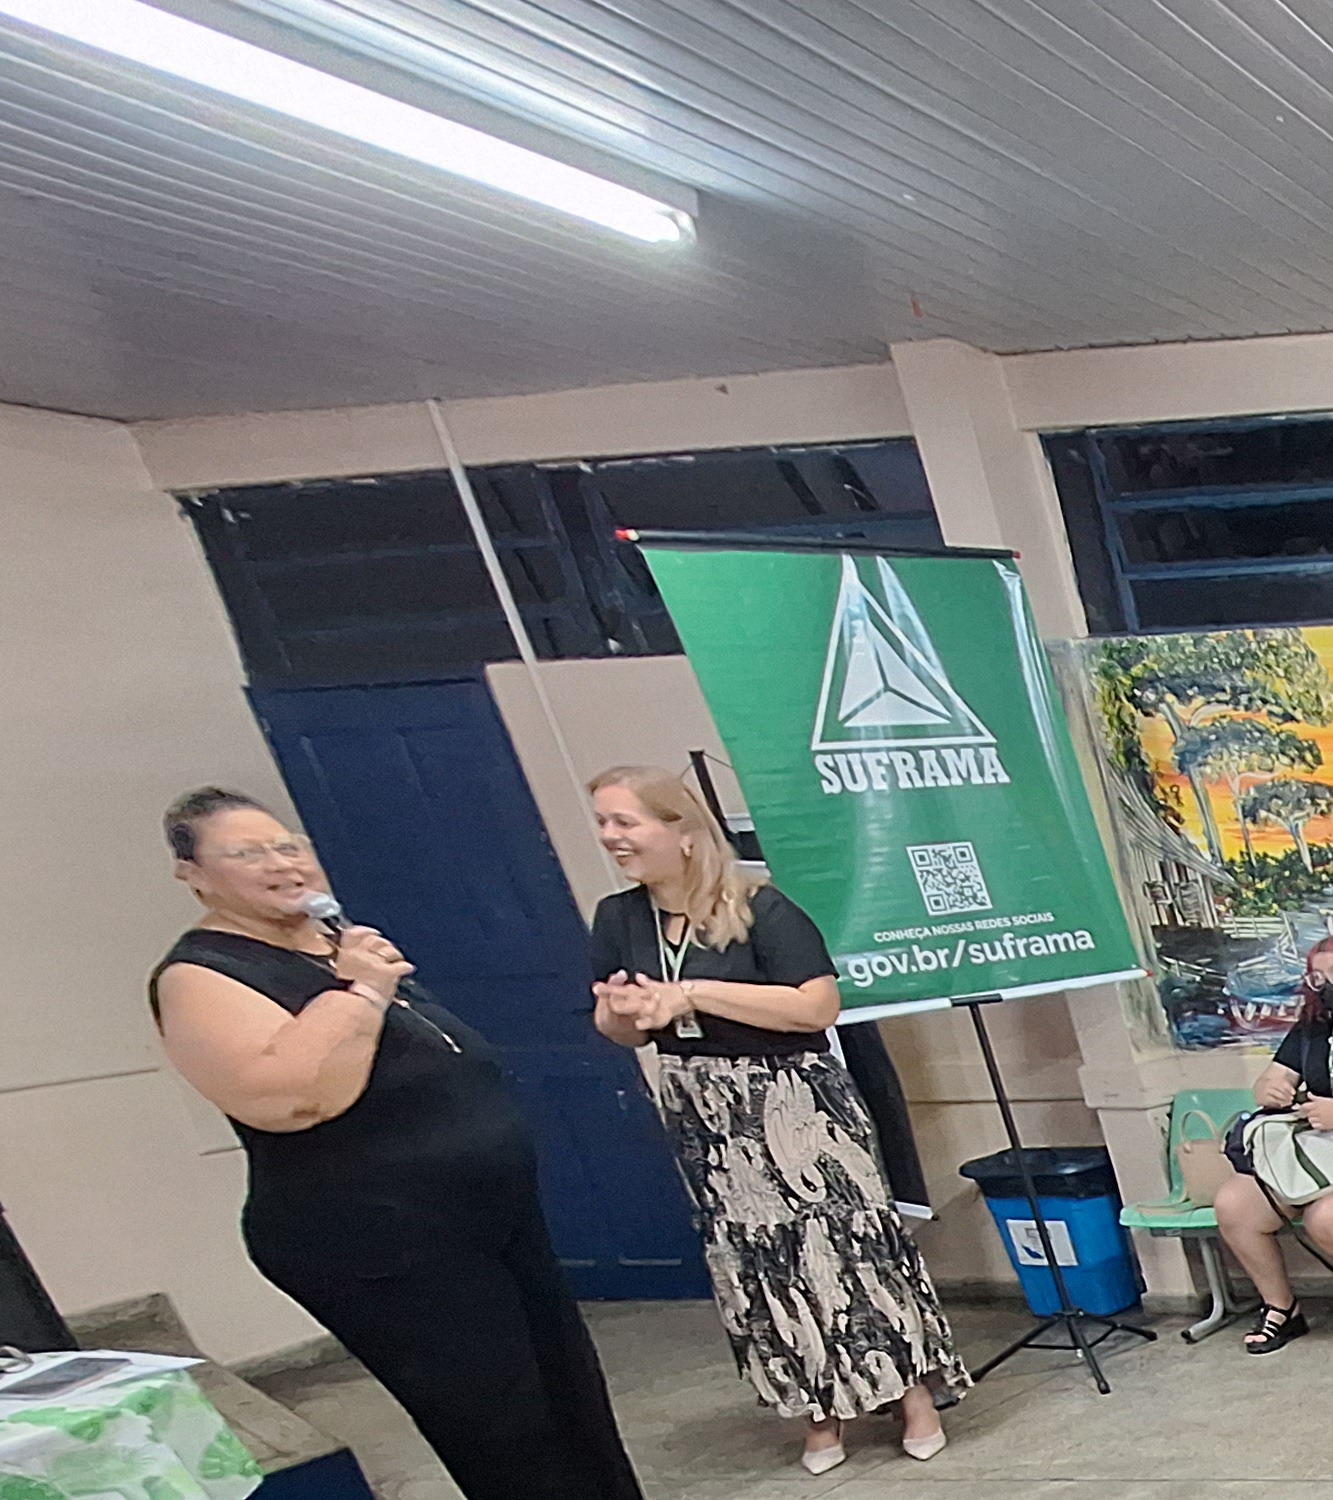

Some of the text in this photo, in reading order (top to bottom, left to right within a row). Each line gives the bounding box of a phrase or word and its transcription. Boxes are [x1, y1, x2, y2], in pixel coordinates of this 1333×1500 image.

[814, 747, 1011, 794] SUFRAMA
[873, 912, 1055, 943] CONHEÇA NOSSAS REDES SOCIAIS
[847, 929, 1096, 988] gov.br/suframa
